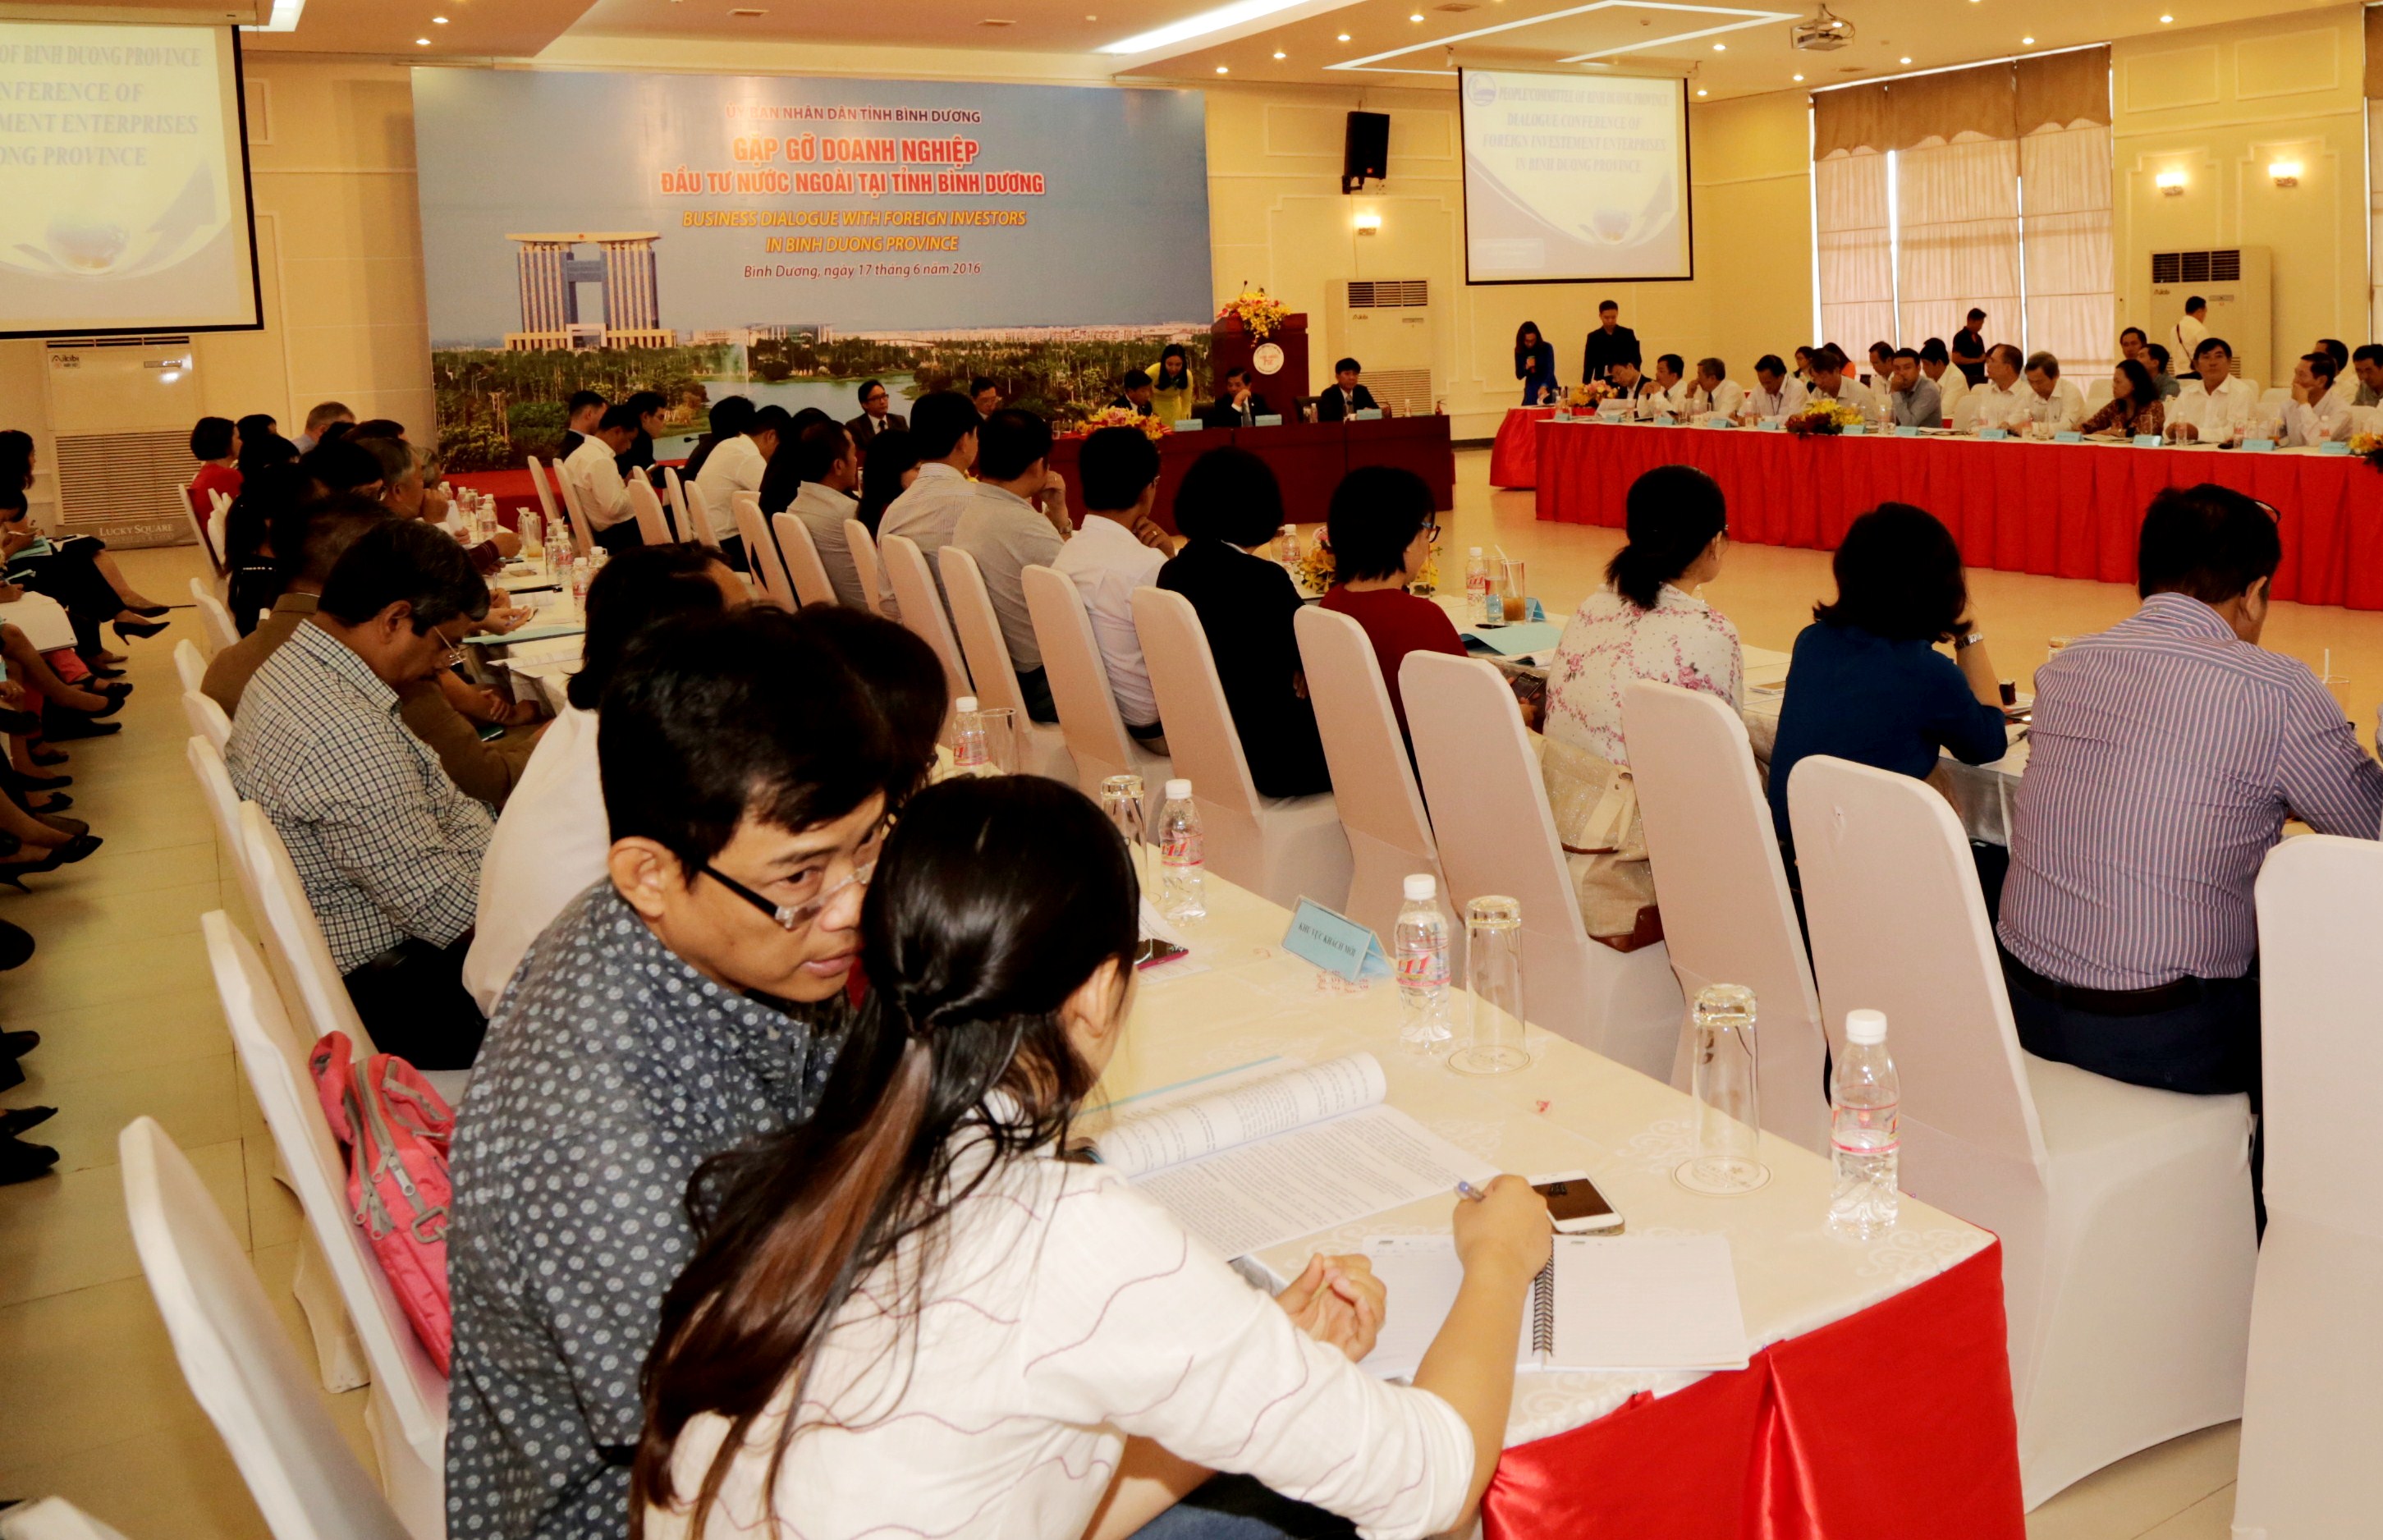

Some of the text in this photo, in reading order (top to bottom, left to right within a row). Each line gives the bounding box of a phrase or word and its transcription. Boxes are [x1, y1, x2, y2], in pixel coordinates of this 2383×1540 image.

[24, 45, 62, 65] BINH
[67, 46, 122, 66] DUONG
[125, 47, 202, 66] PROVINCE
[115, 83, 146, 102] OF
[749, 107, 780, 119] BAN
[782, 105, 824, 120] NHÂN
[827, 106, 858, 121] DÂN
[859, 104, 892, 121] TỈNH
[895, 106, 928, 121] BÌNH
[931, 108, 982, 123] DƯƠNG
[1507, 112, 1643, 131] DIALOGUE CONFERENCE OF
[62, 114, 199, 135] ENTERPRISES
[733, 134, 978, 167] GẶP GỠ DOANH NGHIỆP
[1483, 134, 1528, 148] FOREIGN
[1603, 137, 1667, 152] ENTERPRISES
[44, 146, 148, 167] PROVINCE
[1593, 158, 1642, 174] PROVINCE
[661, 166, 1044, 196] ĐẦU TƯ NƯỚC NGOÀI TẠI TỈNH BÌNH DƯƠNG
[682, 211, 1027, 227] BUSINESS DIALOGUE WITH FOREIGN INVESTORS
[765, 235, 959, 254] IN BINH DUONG PROVINCE
[775, 264, 822, 281] Dương,
[859, 264, 873, 277] 17
[874, 263, 910, 278] tháng
[913, 263, 921, 275] 6
[952, 262, 982, 275] 2016
[99, 524, 175, 537] LUCKY SQUARE
